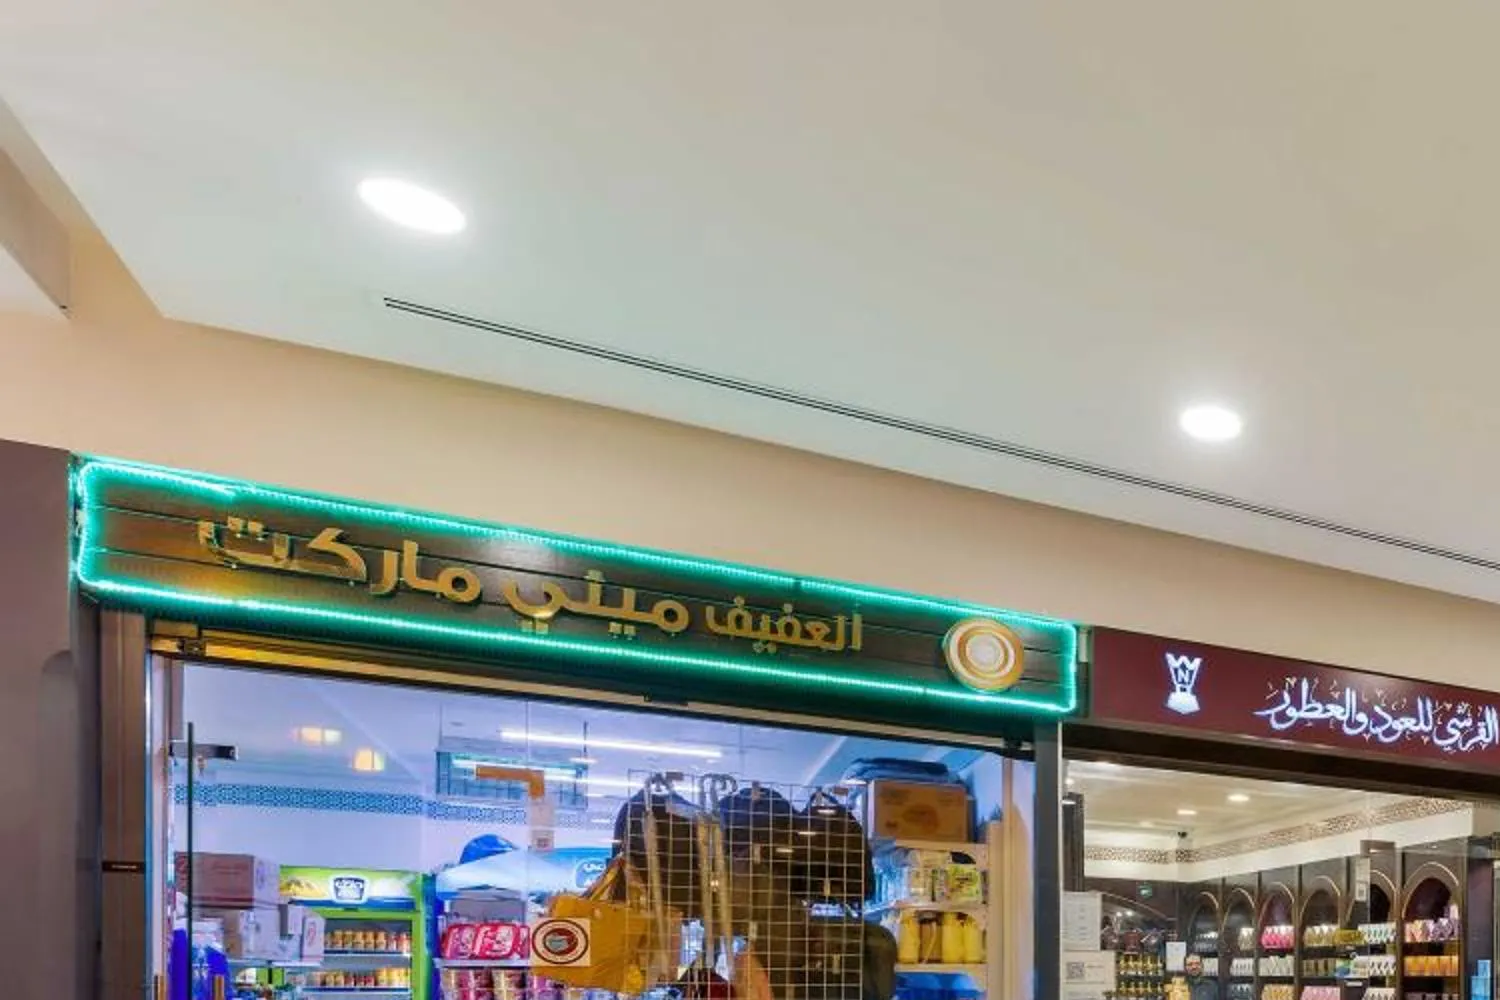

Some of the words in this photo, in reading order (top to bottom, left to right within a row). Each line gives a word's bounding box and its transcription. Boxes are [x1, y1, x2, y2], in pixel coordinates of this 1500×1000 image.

[198, 515, 482, 603] ماركت
[503, 569, 690, 636] ميني
[705, 595, 862, 653] العفيف
[1253, 677, 1370, 738] والعطور
[1369, 694, 1434, 744] للعود
